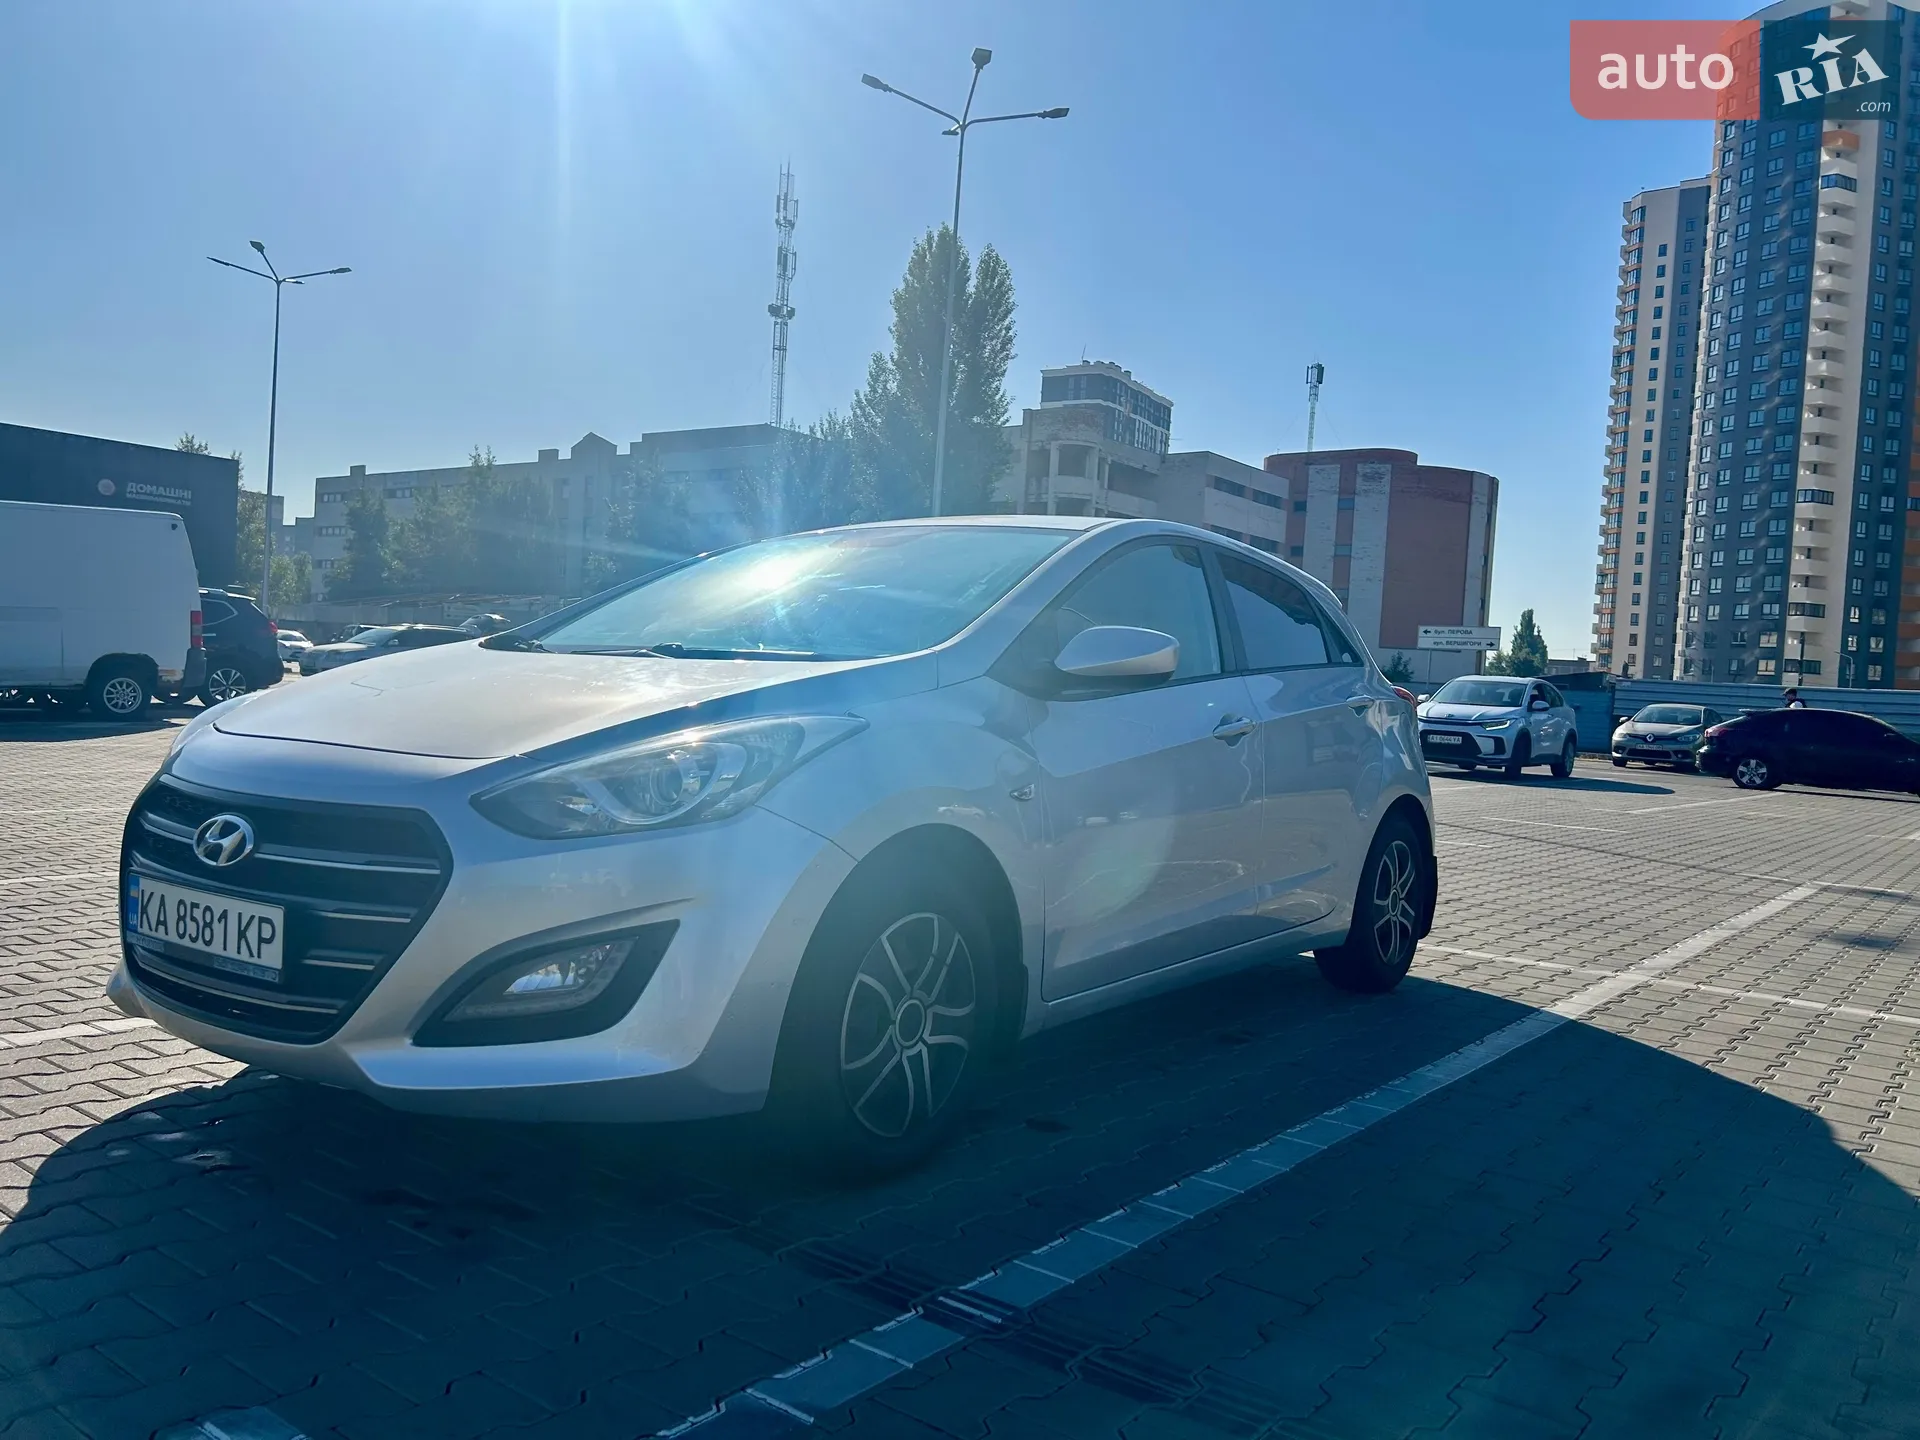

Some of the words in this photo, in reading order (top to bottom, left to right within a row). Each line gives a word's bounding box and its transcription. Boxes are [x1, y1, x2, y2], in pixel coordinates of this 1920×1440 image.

[126, 482, 192, 499] ДОМАШНІ
[139, 889, 169, 936] KA
[175, 899, 229, 951] 8581
[237, 912, 277, 959] KP
